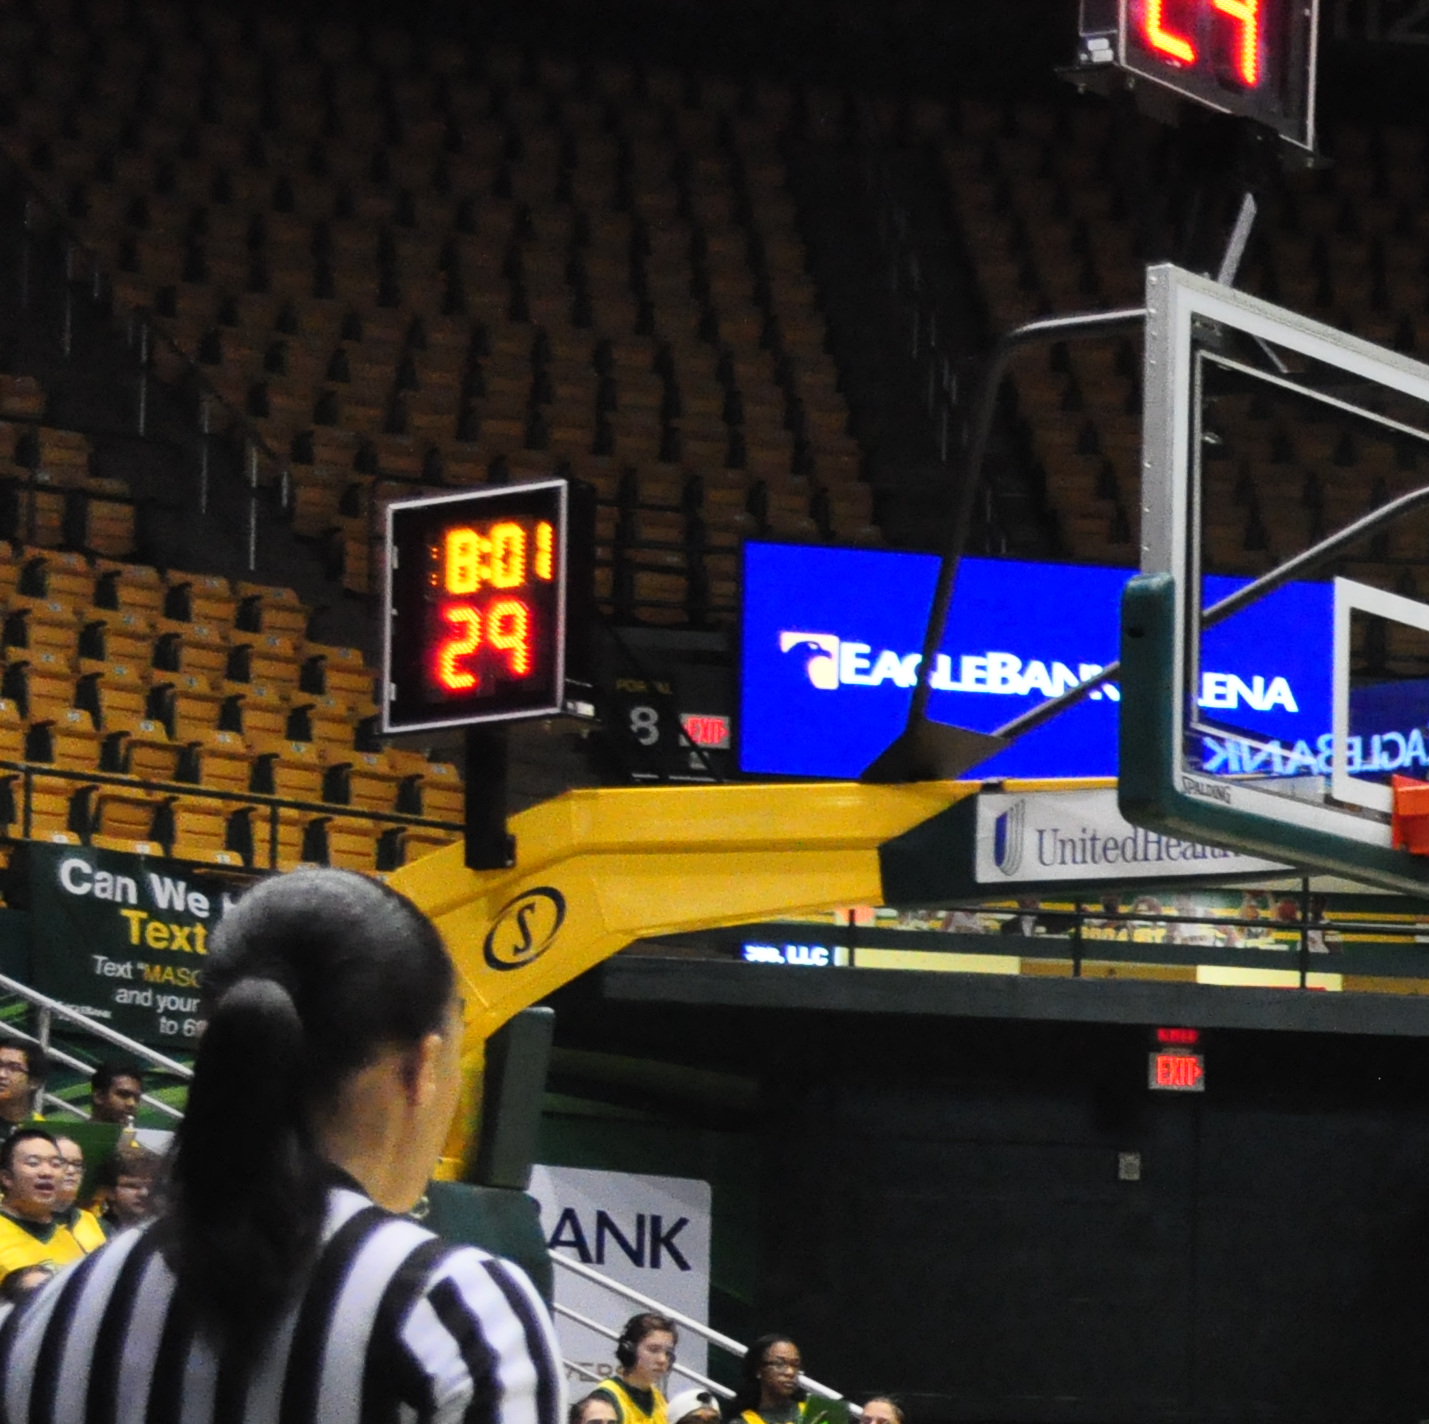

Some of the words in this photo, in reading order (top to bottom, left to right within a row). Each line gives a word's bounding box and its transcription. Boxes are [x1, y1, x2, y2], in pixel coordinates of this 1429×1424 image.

[445, 522, 553, 594] 8:01
[439, 599, 529, 691] 29
[629, 706, 660, 746] 8
[60, 858, 138, 905] Can
[149, 872, 210, 918] We
[120, 908, 209, 954] Text
[93, 955, 133, 979] Text
[115, 988, 152, 1006] and
[160, 1016, 178, 1034] to
[1157, 1055, 1196, 1086] EXIT
